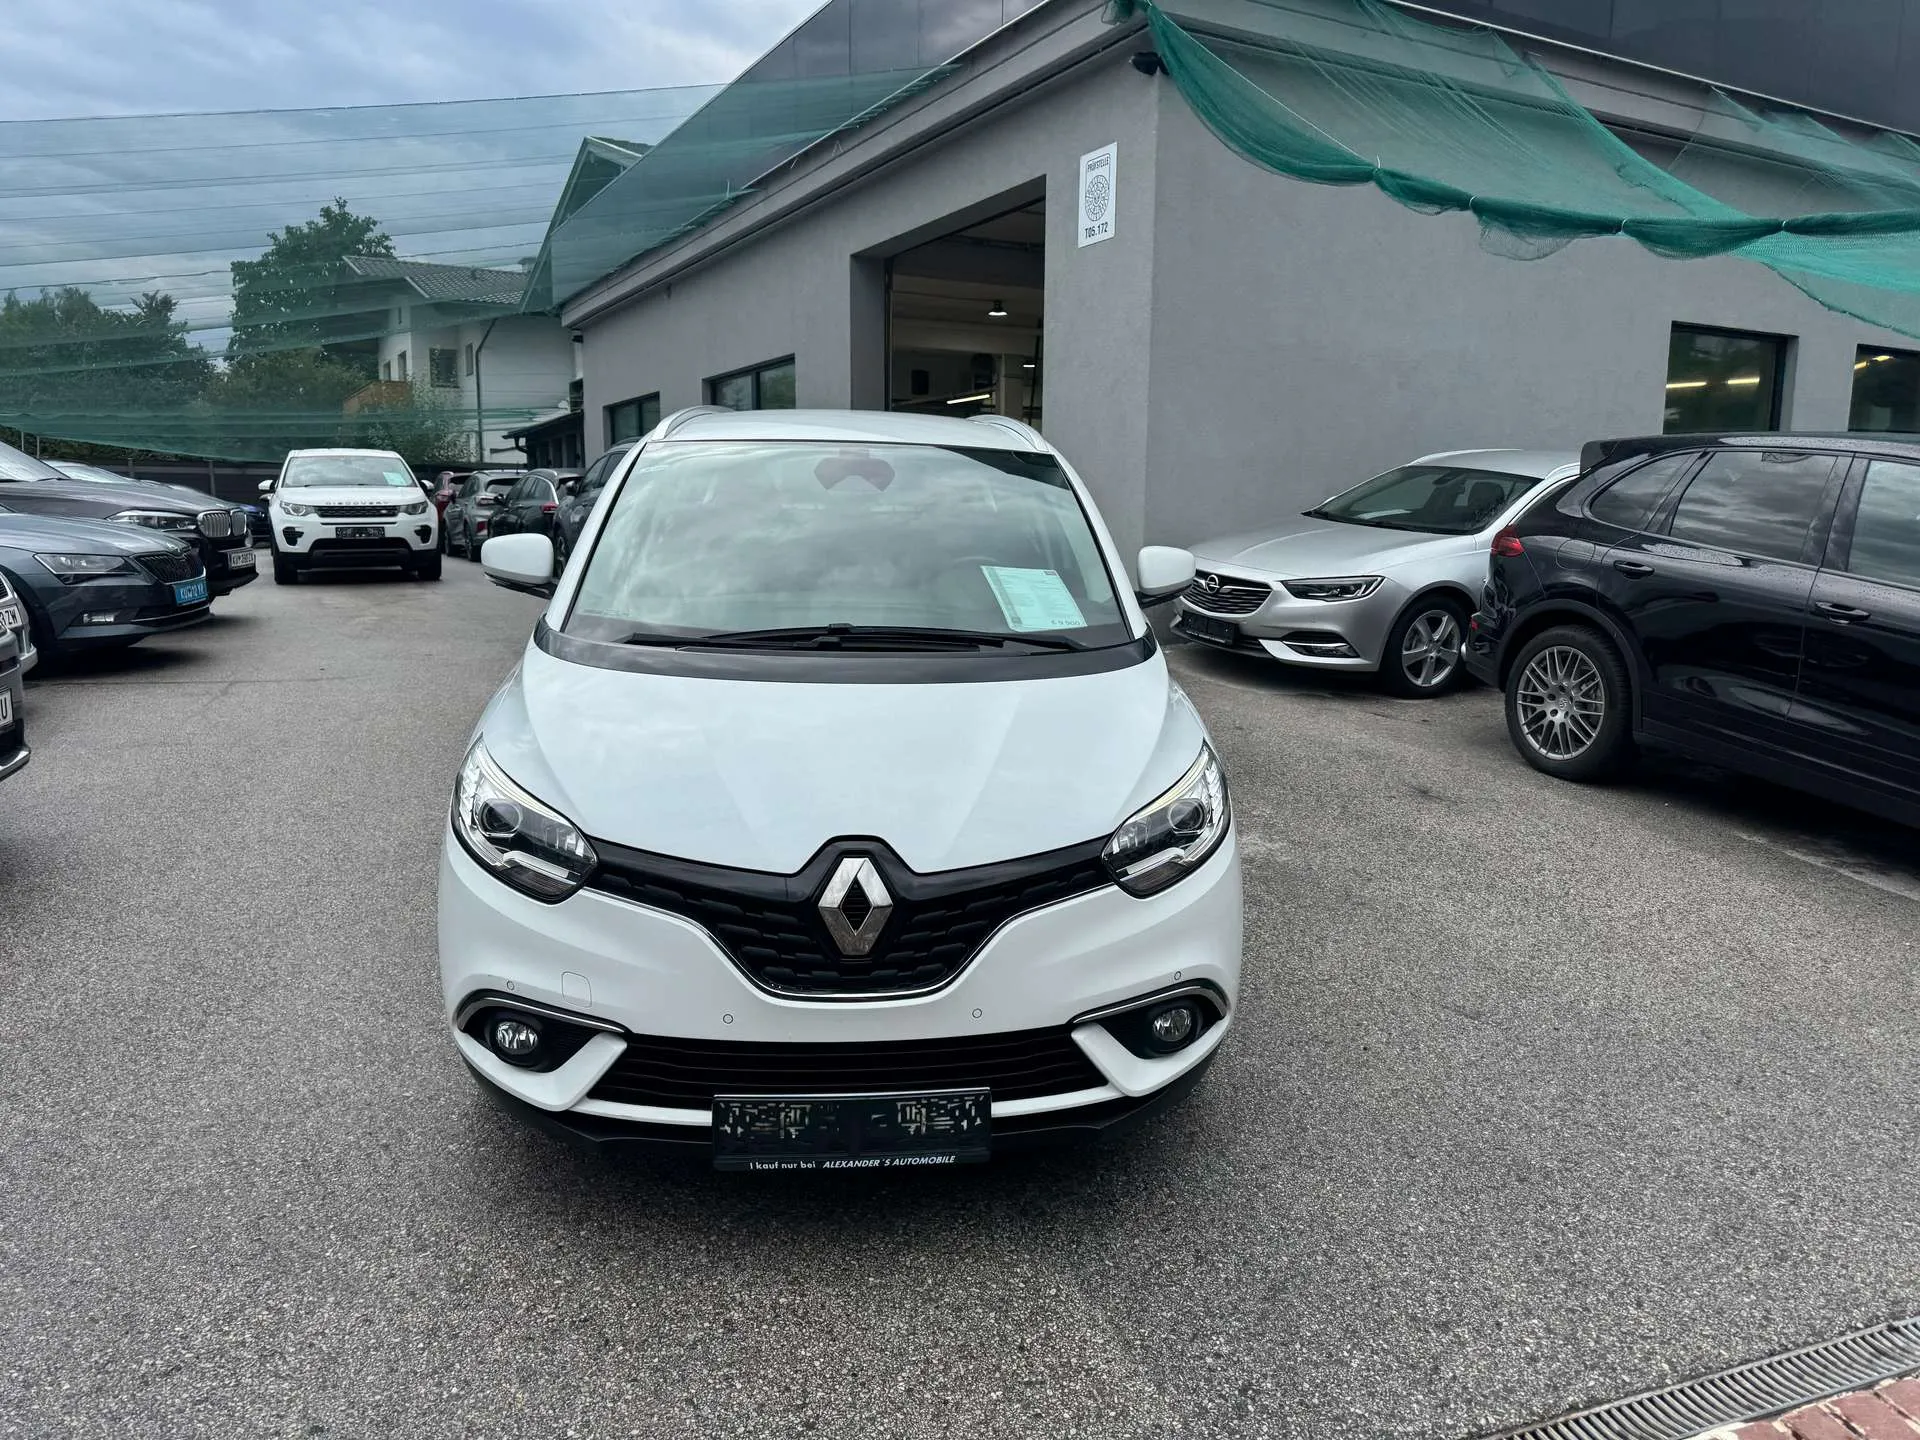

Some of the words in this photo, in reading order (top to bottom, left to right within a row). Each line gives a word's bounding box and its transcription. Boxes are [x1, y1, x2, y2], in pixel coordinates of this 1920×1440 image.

[755, 1161, 779, 1169] kauf
[822, 1160, 880, 1169] ALEXANDER
[891, 1155, 955, 1166] AUTOMOBILE
